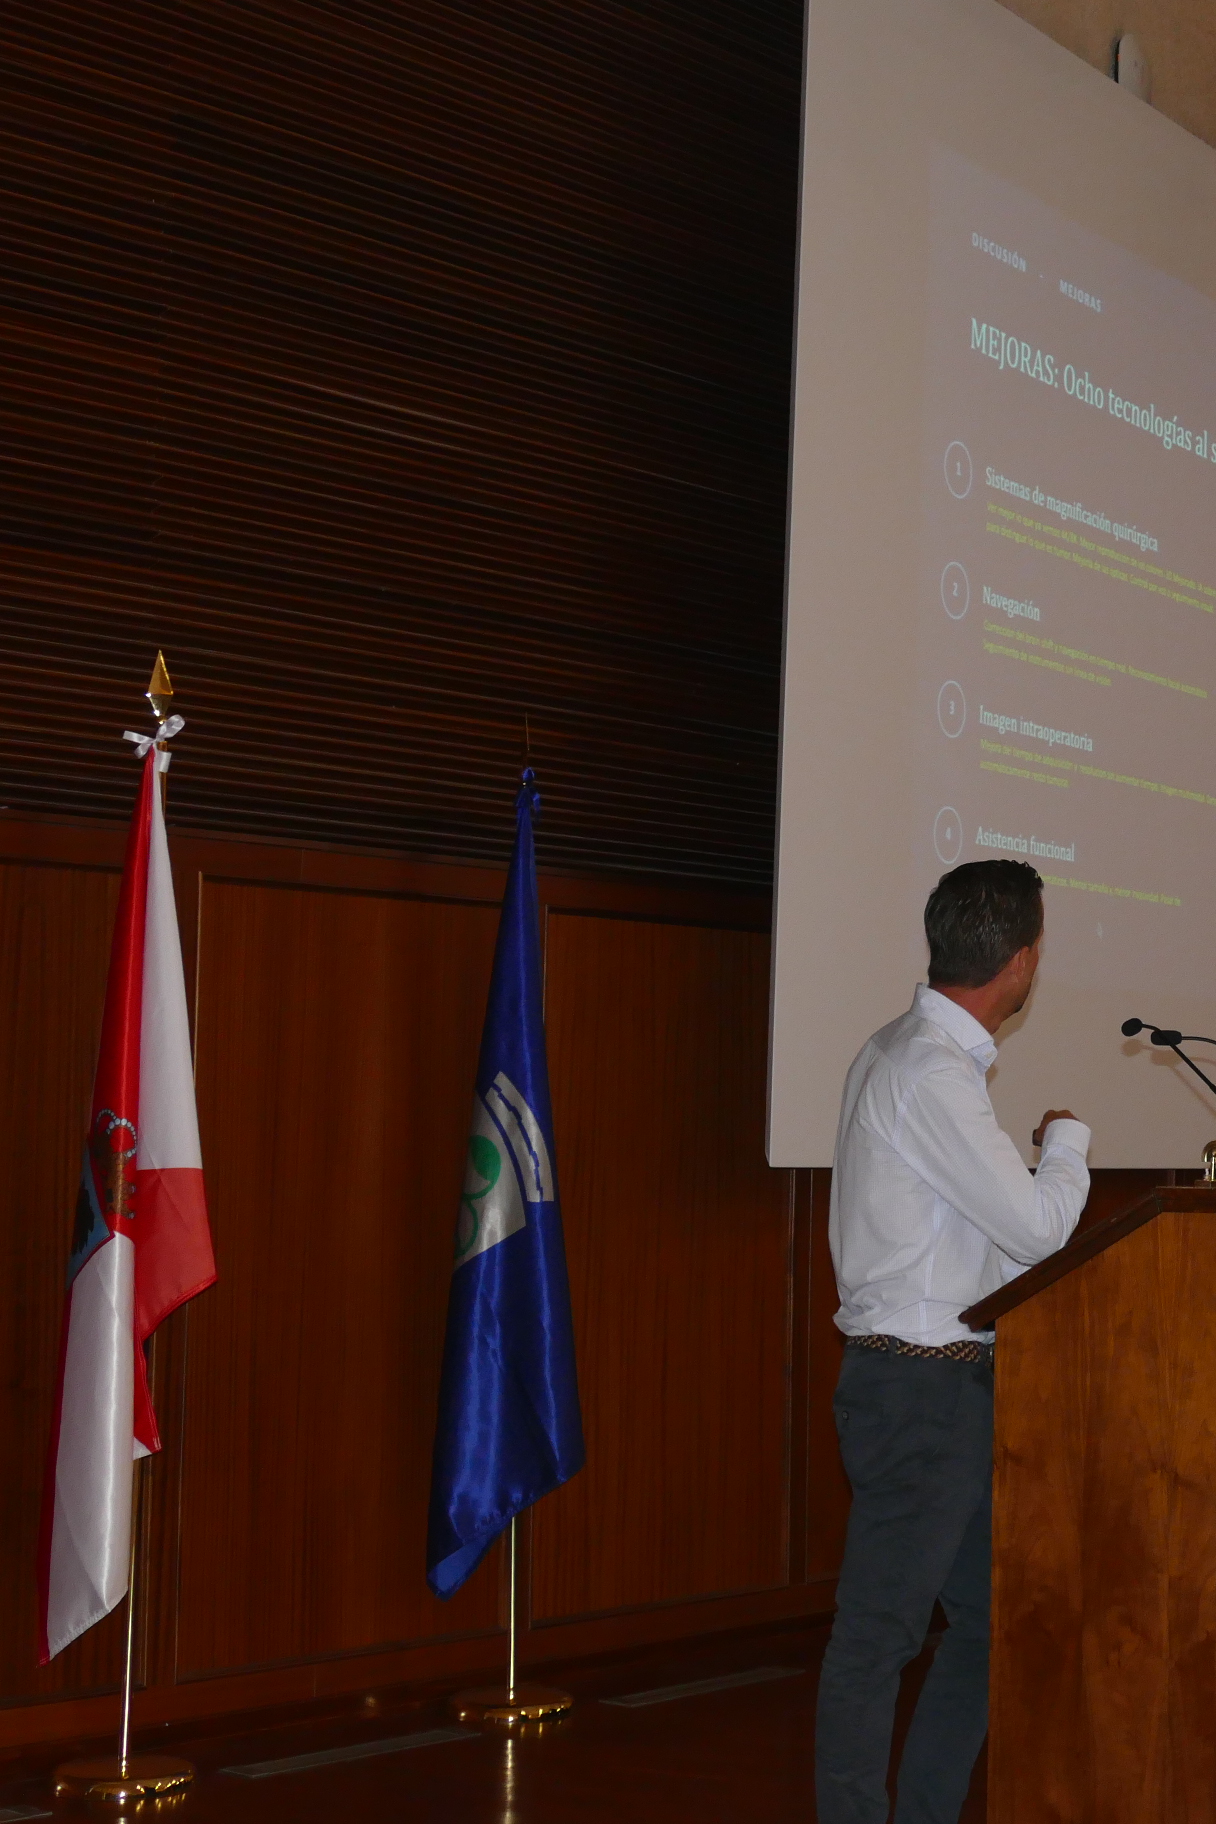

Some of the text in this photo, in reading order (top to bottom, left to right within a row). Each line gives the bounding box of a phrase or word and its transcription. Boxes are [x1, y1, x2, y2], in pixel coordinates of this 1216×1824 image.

[971, 232, 1027, 272] DISCUSIÓN
[1059, 279, 1102, 313] MEJORAS
[970, 317, 1059, 388] MEJORAS:
[1063, 364, 1104, 409] Ocho
[1108, 388, 1192, 449] tecnologías
[1195, 430, 1208, 459] al
[985, 466, 1159, 552] Sistemas de magnificación quirúrgica
[982, 585, 1040, 621] Navegación
[979, 705, 1093, 752] Imagen intraoperatoria
[975, 826, 1076, 862] Asistencia funcional
